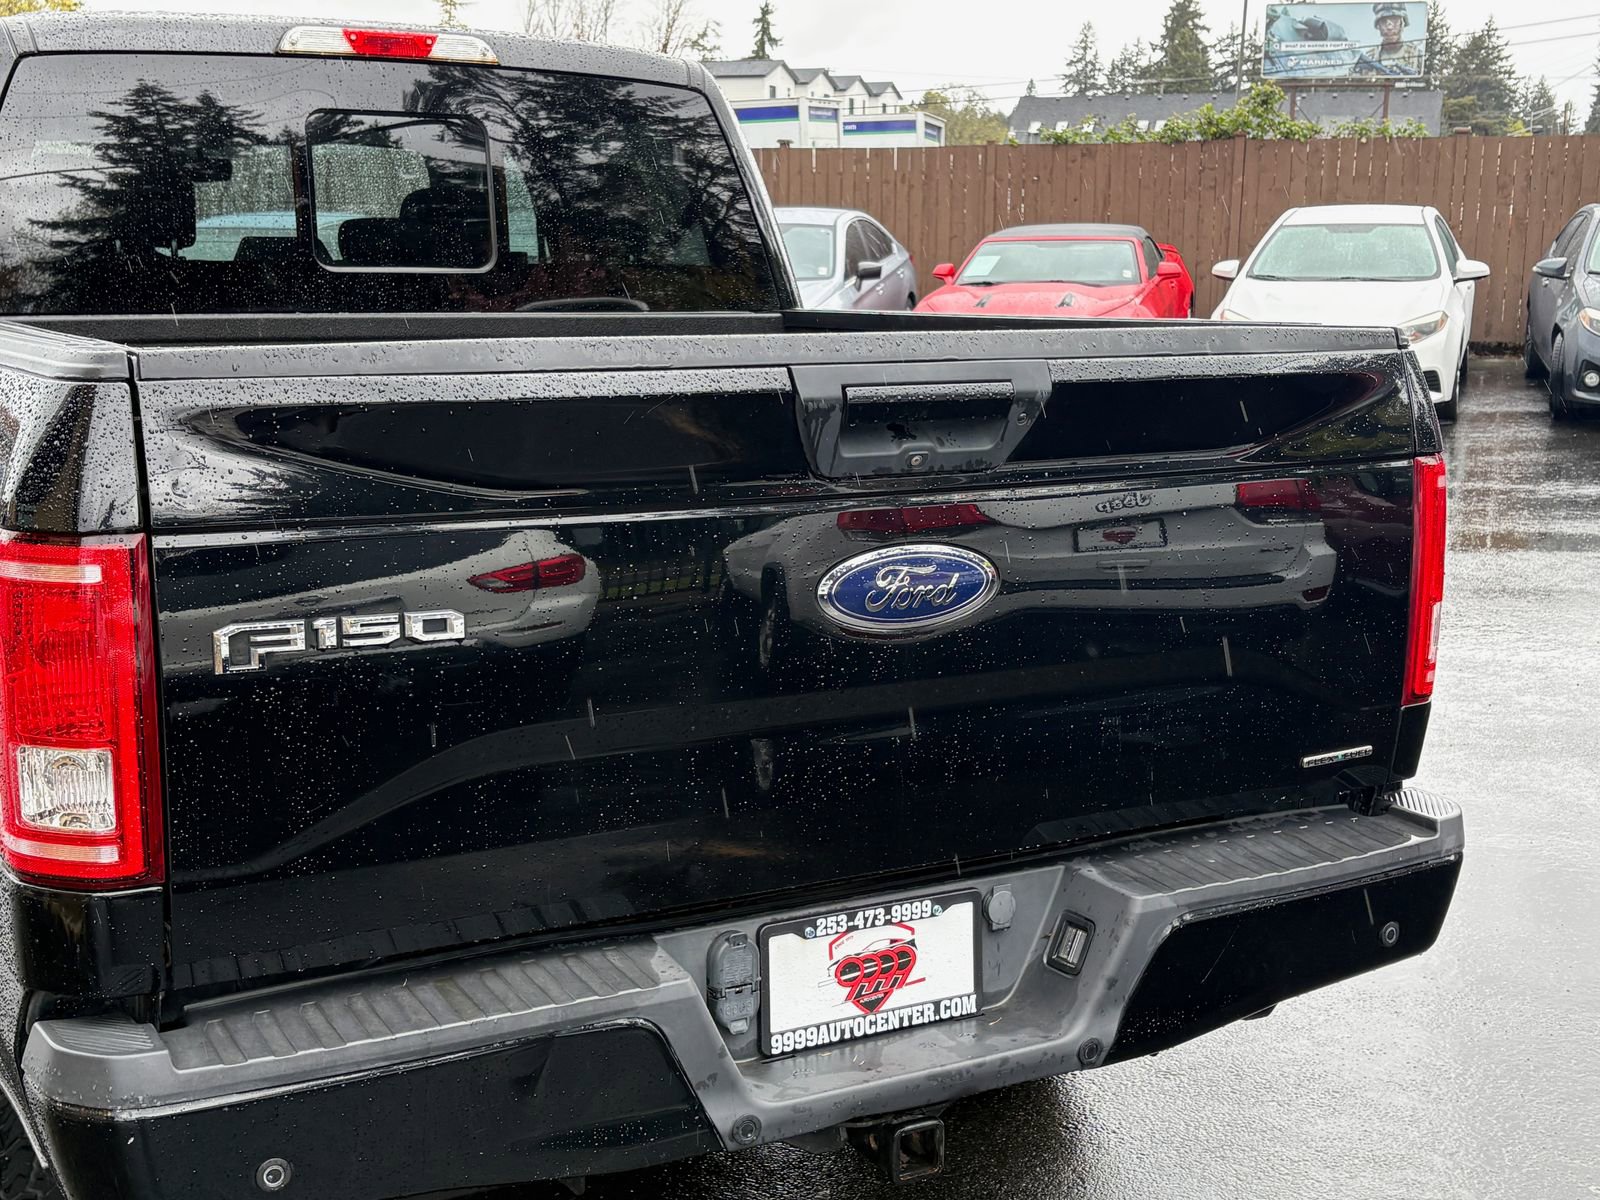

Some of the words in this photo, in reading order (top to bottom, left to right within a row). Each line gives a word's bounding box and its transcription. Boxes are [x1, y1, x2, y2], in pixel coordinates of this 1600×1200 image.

[865, 564, 959, 612] Ford
[1303, 756, 1335, 767] FLEX
[1343, 749, 1372, 760] FUEL
[815, 900, 932, 937] 253-473-9999
[770, 994, 977, 1055] 9999AUTOCENTER.COM
